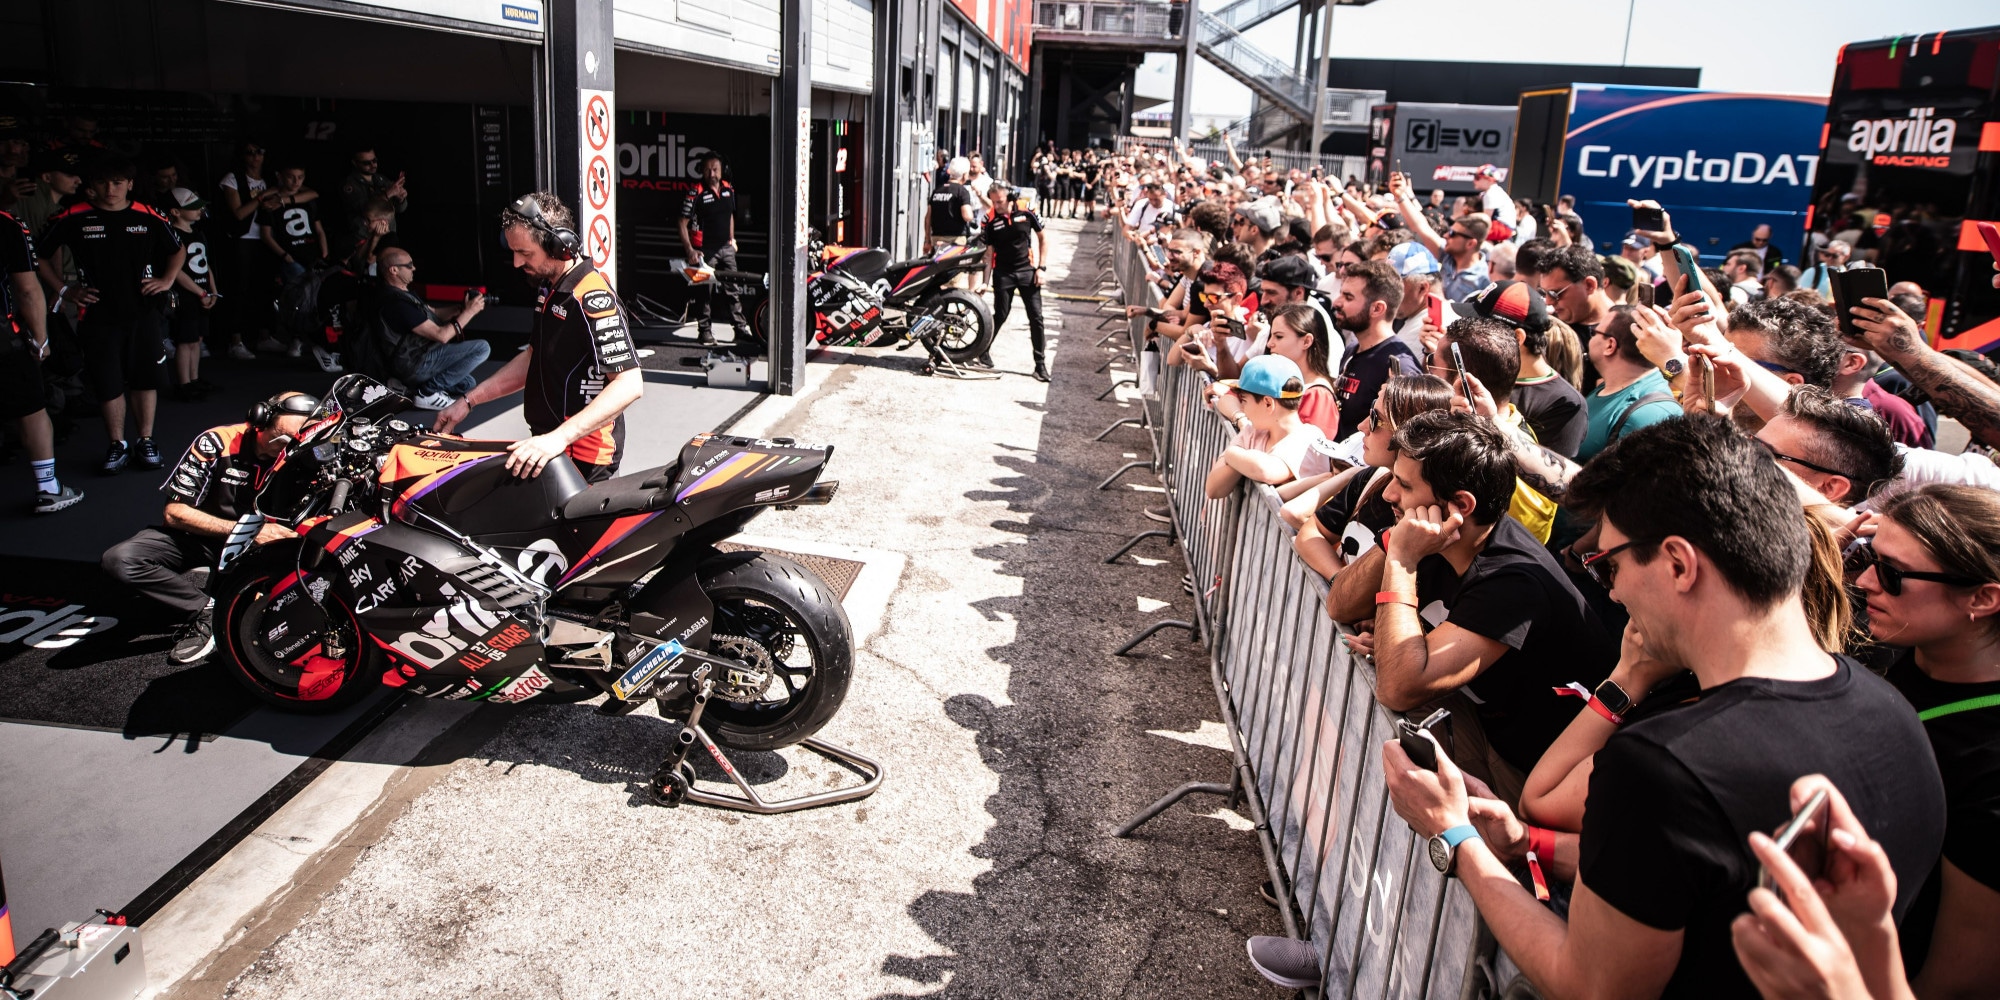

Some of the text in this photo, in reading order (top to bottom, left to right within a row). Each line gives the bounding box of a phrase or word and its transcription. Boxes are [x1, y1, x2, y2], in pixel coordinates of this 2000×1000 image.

[304, 120, 337, 141] 12
[1848, 107, 1957, 160] aprilia
[616, 134, 711, 183] prilia
[1578, 144, 1820, 189] CryptoDAT
[1873, 155, 1950, 168] RACING
[932, 193, 953, 202] CREW
[283, 208, 312, 237] a
[187, 241, 208, 274] a
[414, 449, 461, 460] aprilia
[348, 563, 373, 589] sky
[268, 620, 289, 640] SC
[457, 652, 493, 673] ALL
[487, 623, 532, 652] STARS
[631, 645, 675, 684] MICHELIN
[443, 686, 473, 701] CASE
